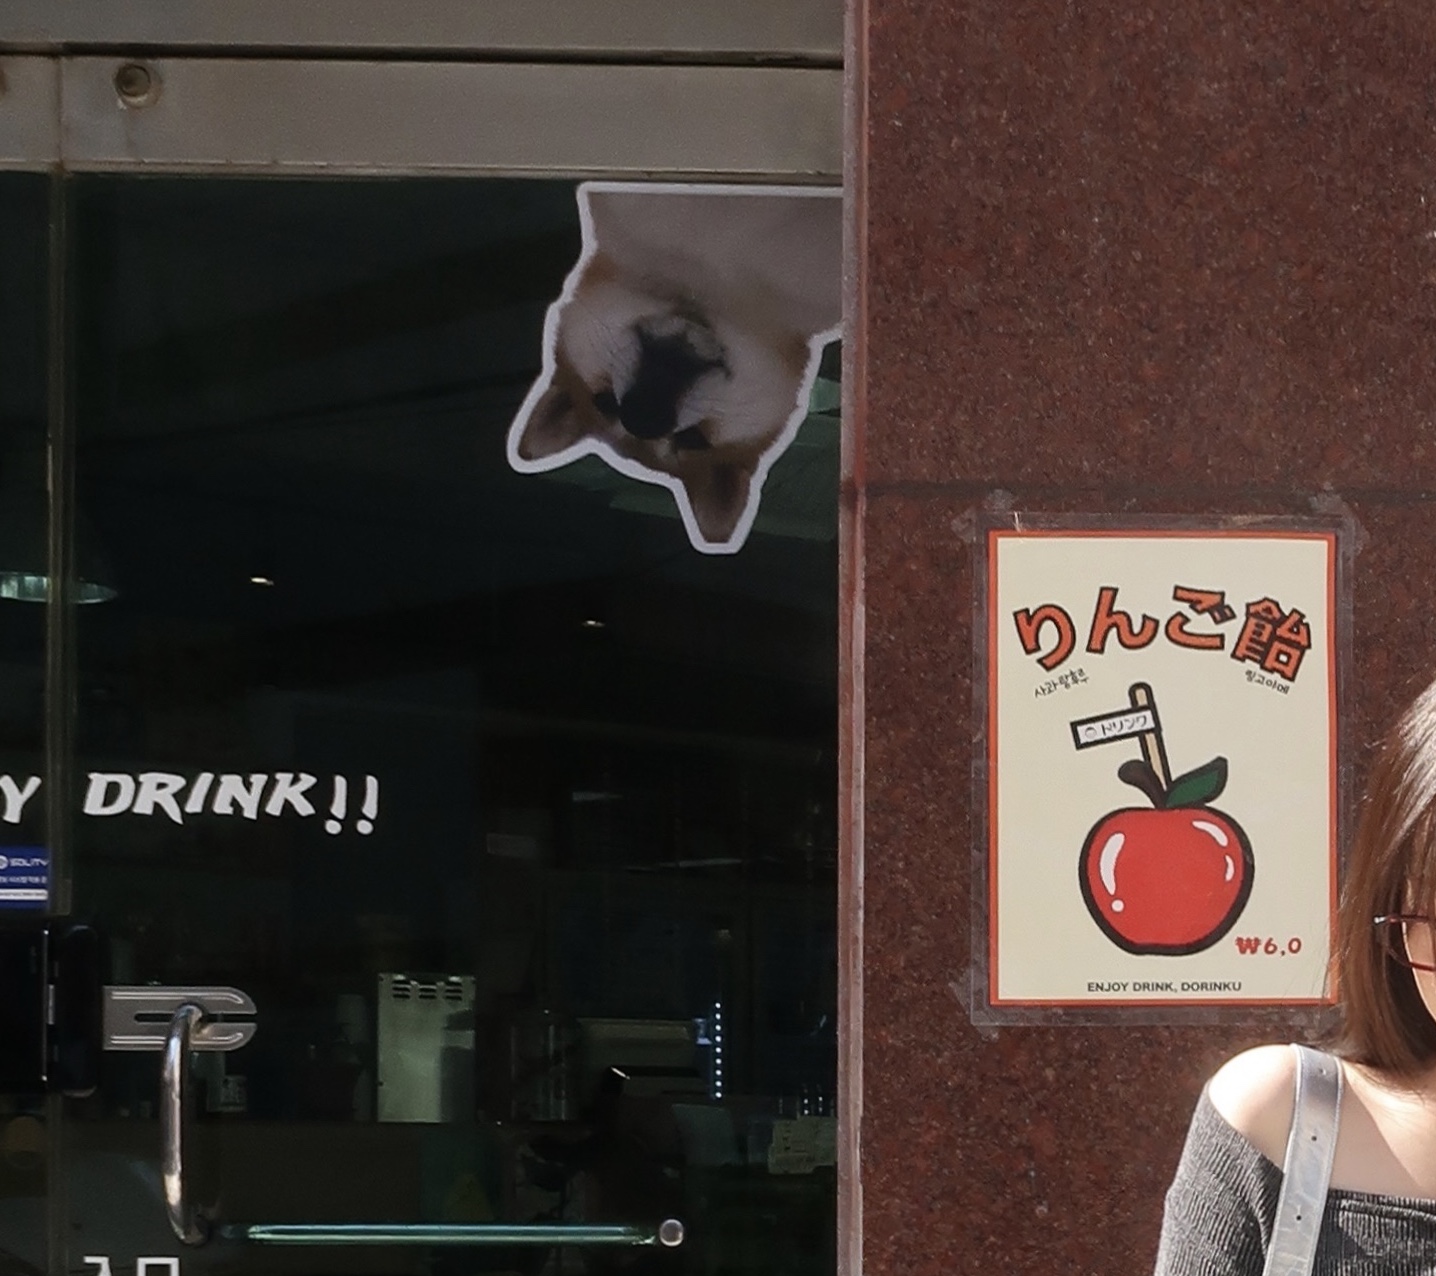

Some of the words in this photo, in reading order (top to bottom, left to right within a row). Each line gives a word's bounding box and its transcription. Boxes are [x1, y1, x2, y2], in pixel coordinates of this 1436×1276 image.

[1013, 585, 1311, 682] りんご飴
[83, 772, 378, 835] DRINK!!
[1087, 982, 1129, 992] ENJOY
[1132, 982, 1177, 993] DRINK,
[1181, 981, 1242, 992] DORINKU
